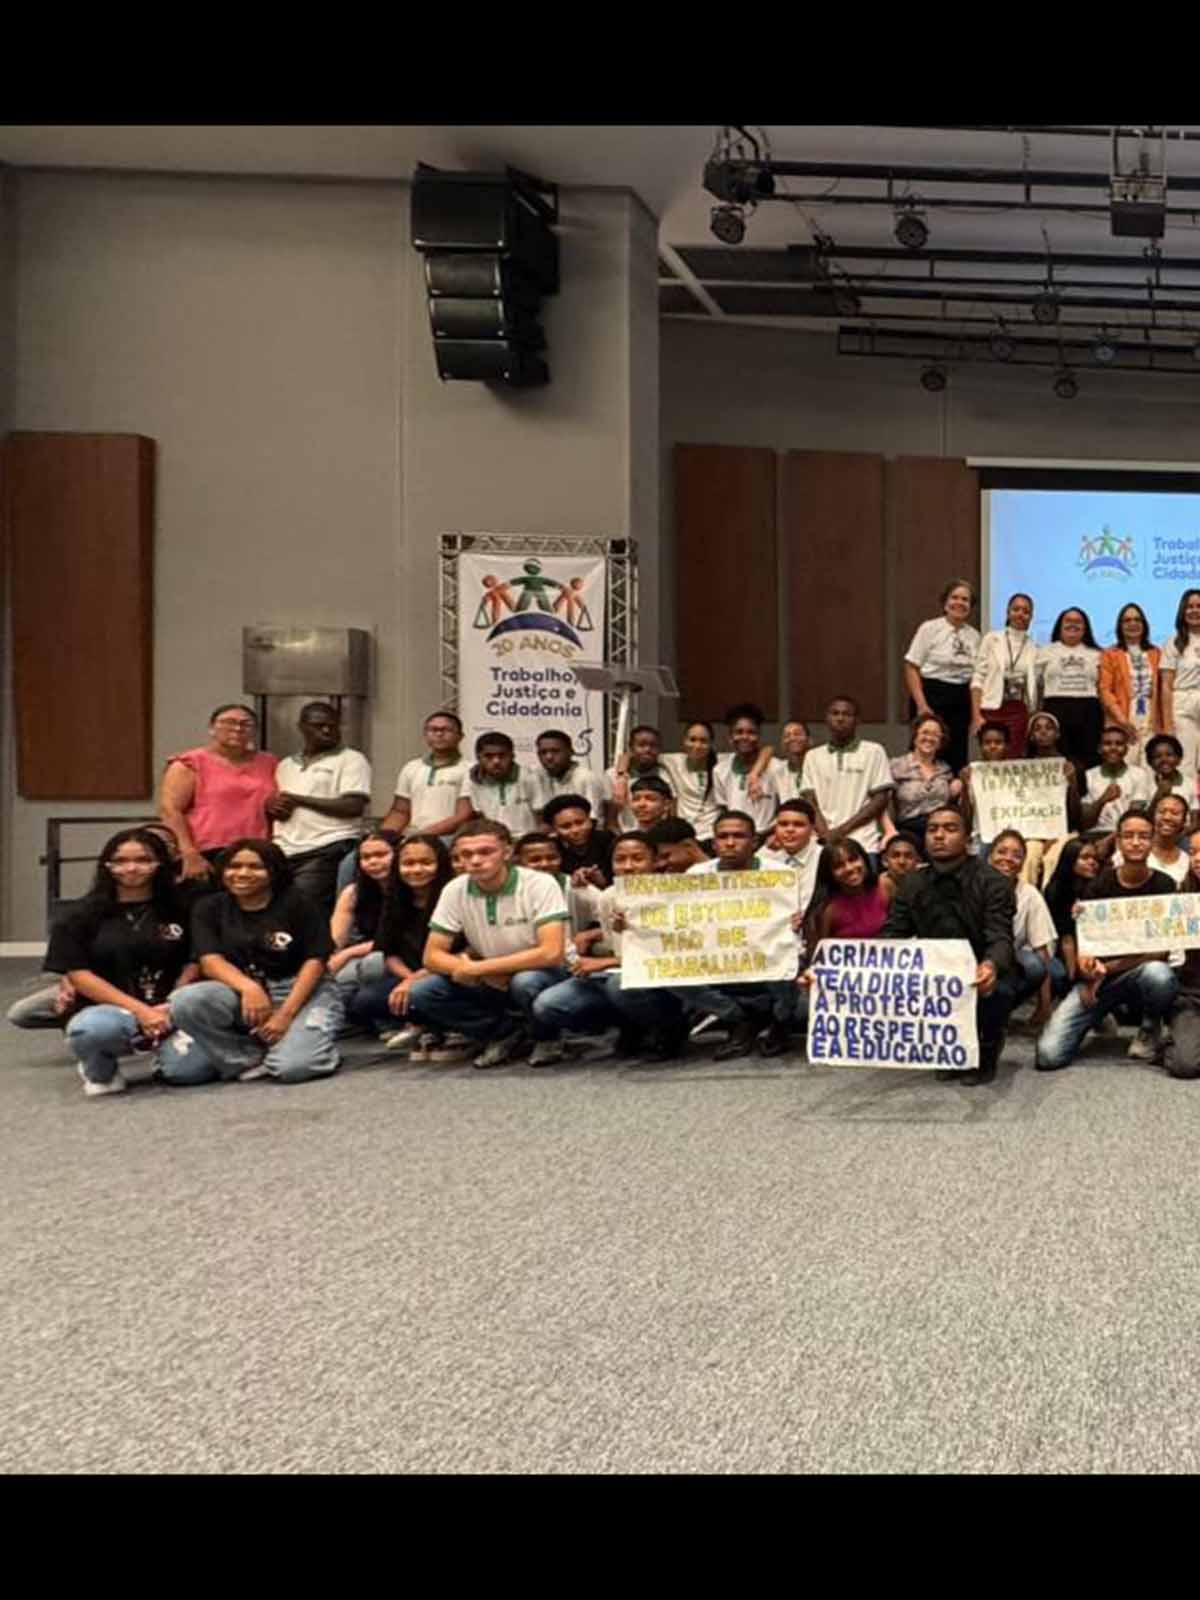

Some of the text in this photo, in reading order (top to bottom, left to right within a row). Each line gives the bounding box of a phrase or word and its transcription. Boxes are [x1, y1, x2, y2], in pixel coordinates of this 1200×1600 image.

[519, 634, 576, 659] ANOS
[490, 667, 578, 685] Trabalho,
[492, 684, 576, 700] Justiça e
[486, 701, 582, 716] Cidadania
[814, 969, 963, 998] TEM DIREITO
[812, 1014, 957, 1046] AO RESPEITO
[813, 1036, 825, 1057] E
[829, 1036, 842, 1057] A
